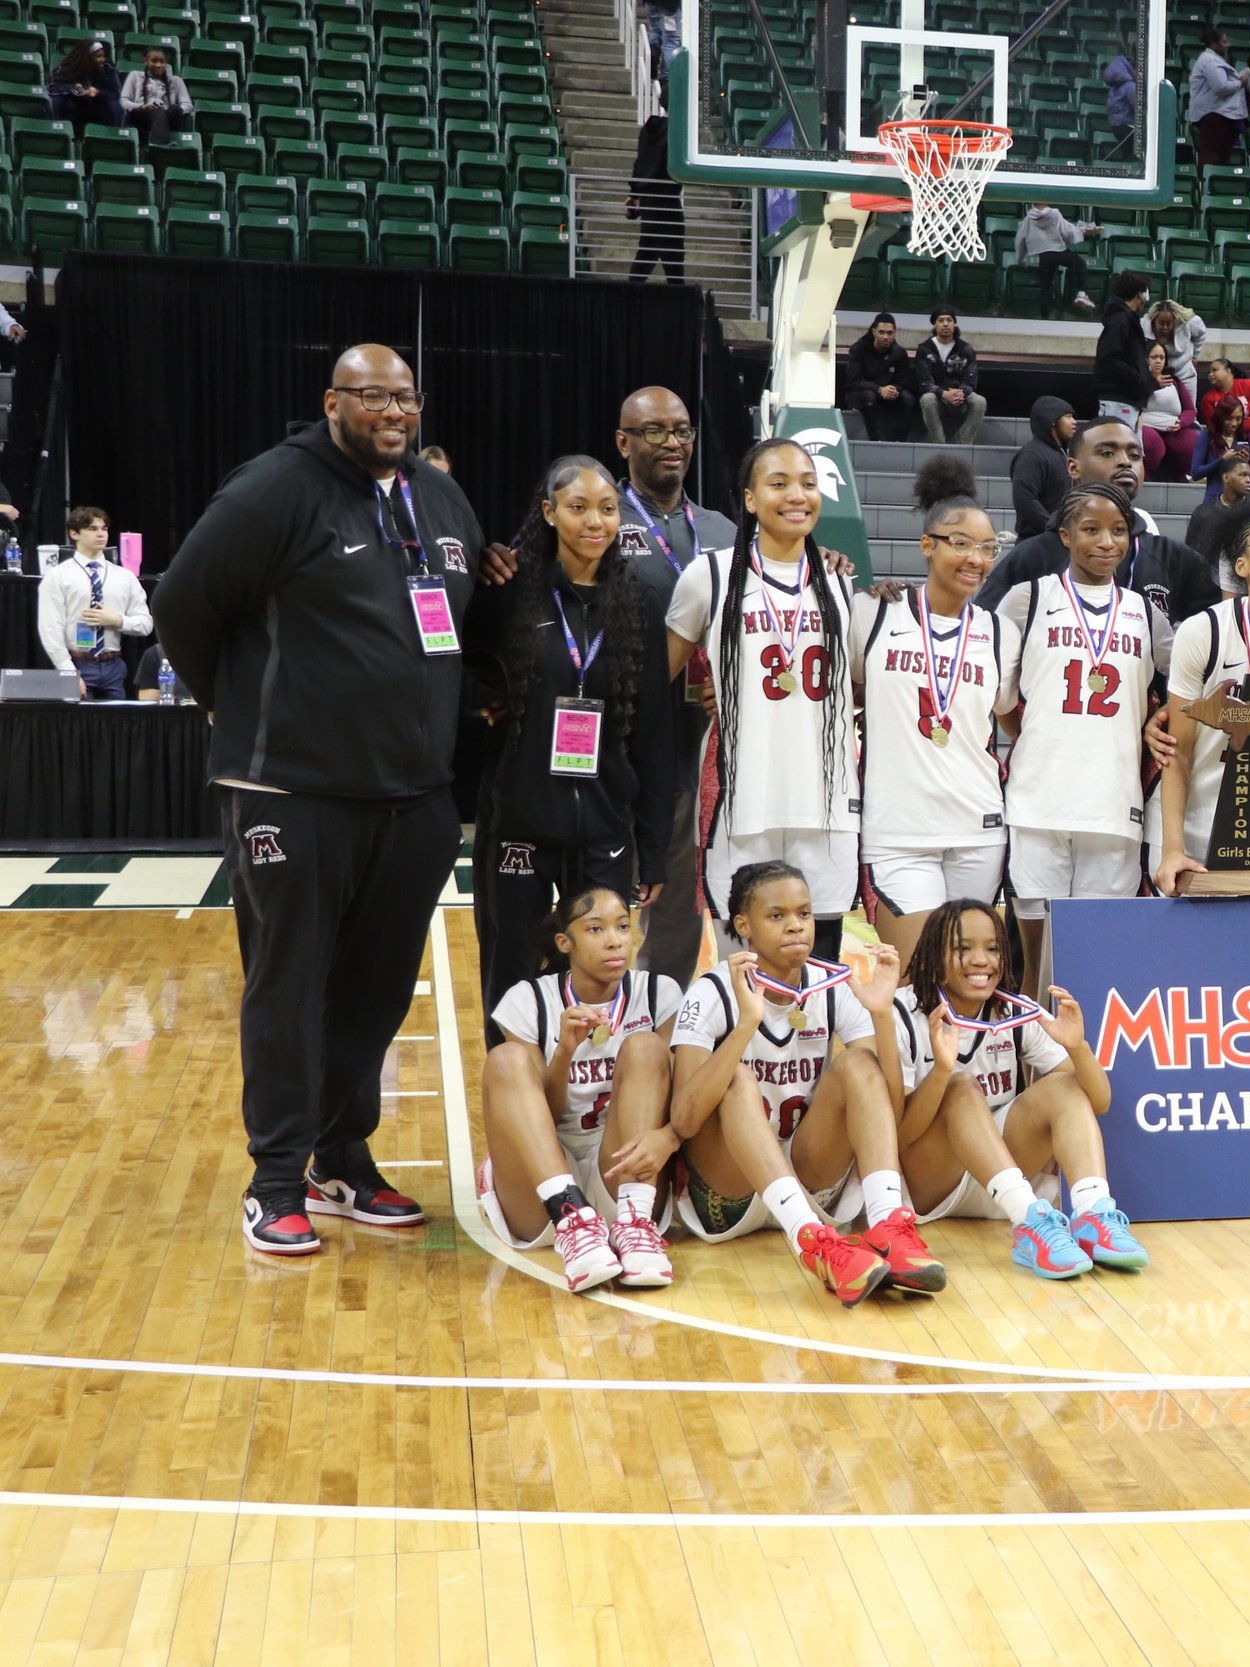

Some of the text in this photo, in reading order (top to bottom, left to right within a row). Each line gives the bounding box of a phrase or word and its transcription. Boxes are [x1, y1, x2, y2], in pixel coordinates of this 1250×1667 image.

[620, 530, 649, 549] M
[444, 545, 467, 567] M
[761, 644, 831, 702] 30
[1062, 658, 1122, 718] 12
[1235, 752, 1250, 839] CHAMPION
[251, 833, 283, 858] M
[501, 847, 533, 868] M
[1217, 847, 1244, 858] Girls
[761, 1095, 809, 1139] 0
